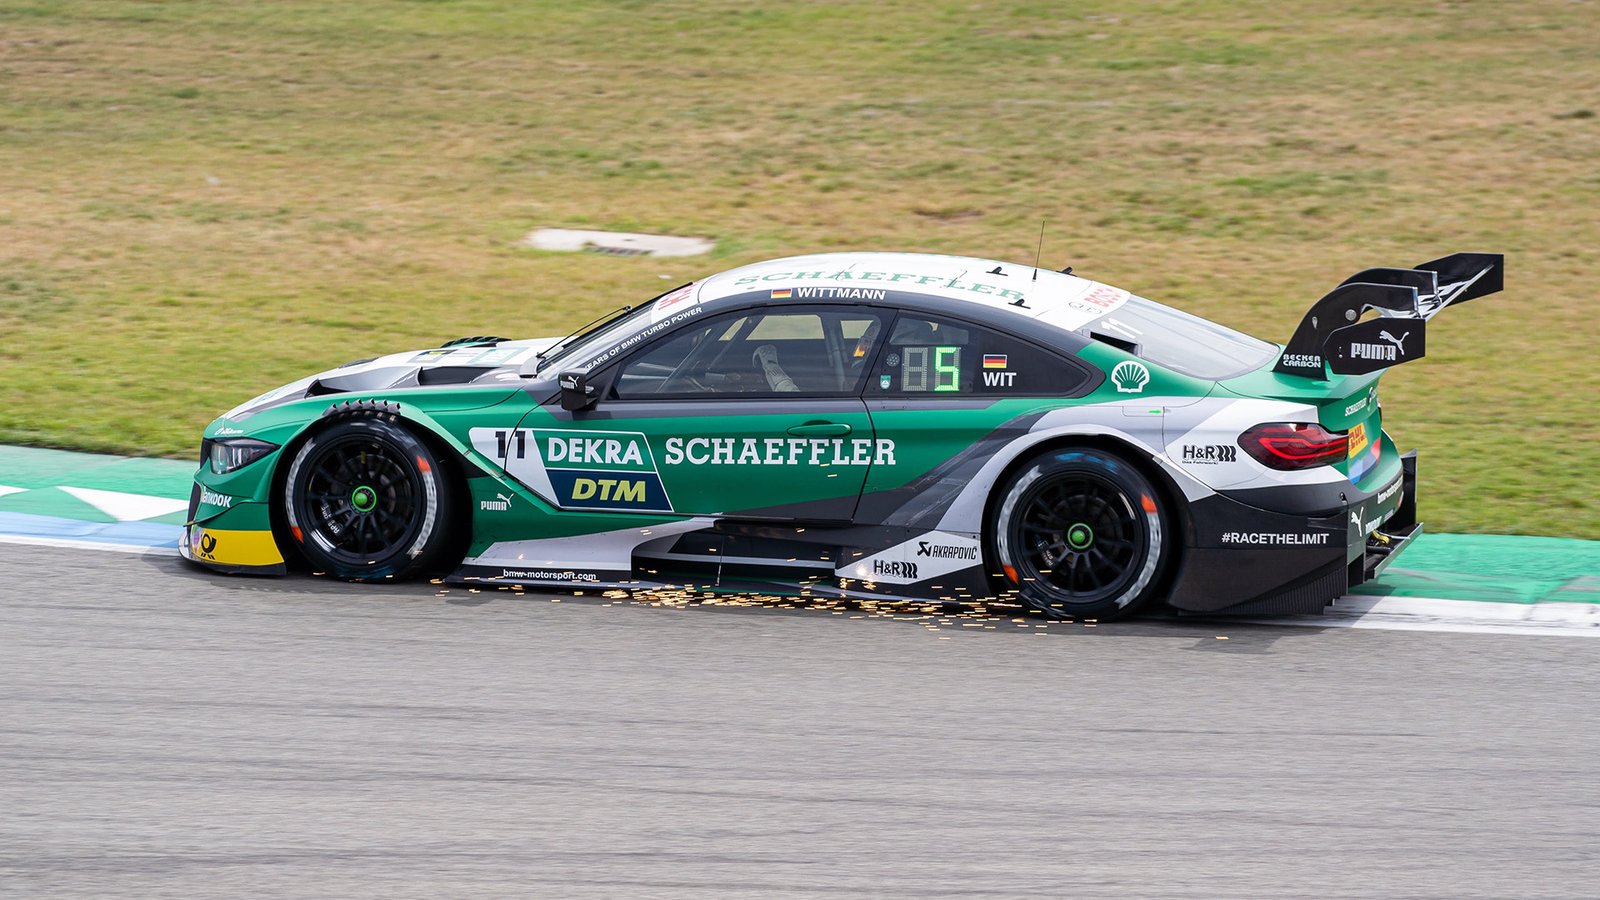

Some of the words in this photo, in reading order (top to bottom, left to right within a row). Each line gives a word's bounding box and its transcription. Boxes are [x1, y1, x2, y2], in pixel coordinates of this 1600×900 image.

[735, 270, 1024, 301] SCHAEFFLER
[797, 286, 887, 301] WITTMANN
[609, 346, 621, 357] OF
[621, 335, 641, 350] BMW
[641, 320, 671, 338] TURBO
[671, 306, 703, 324] POWER
[1283, 353, 1321, 361] BECKER
[1351, 343, 1397, 361] PUMA
[1283, 360, 1321, 368] CARBON
[983, 372, 1017, 387] WIT
[495, 430, 526, 459] 11
[547, 437, 644, 466] DEKRA
[665, 437, 896, 466] SCHAEFFLER
[1183, 444, 1216, 460] H&R
[571, 478, 647, 502] DTM
[480, 500, 507, 511] PUMA
[1221, 531, 1330, 545] #RACETHELIMIT
[502, 568, 597, 581] bmw-motorsport.com
[873, 559, 901, 576] H&R
